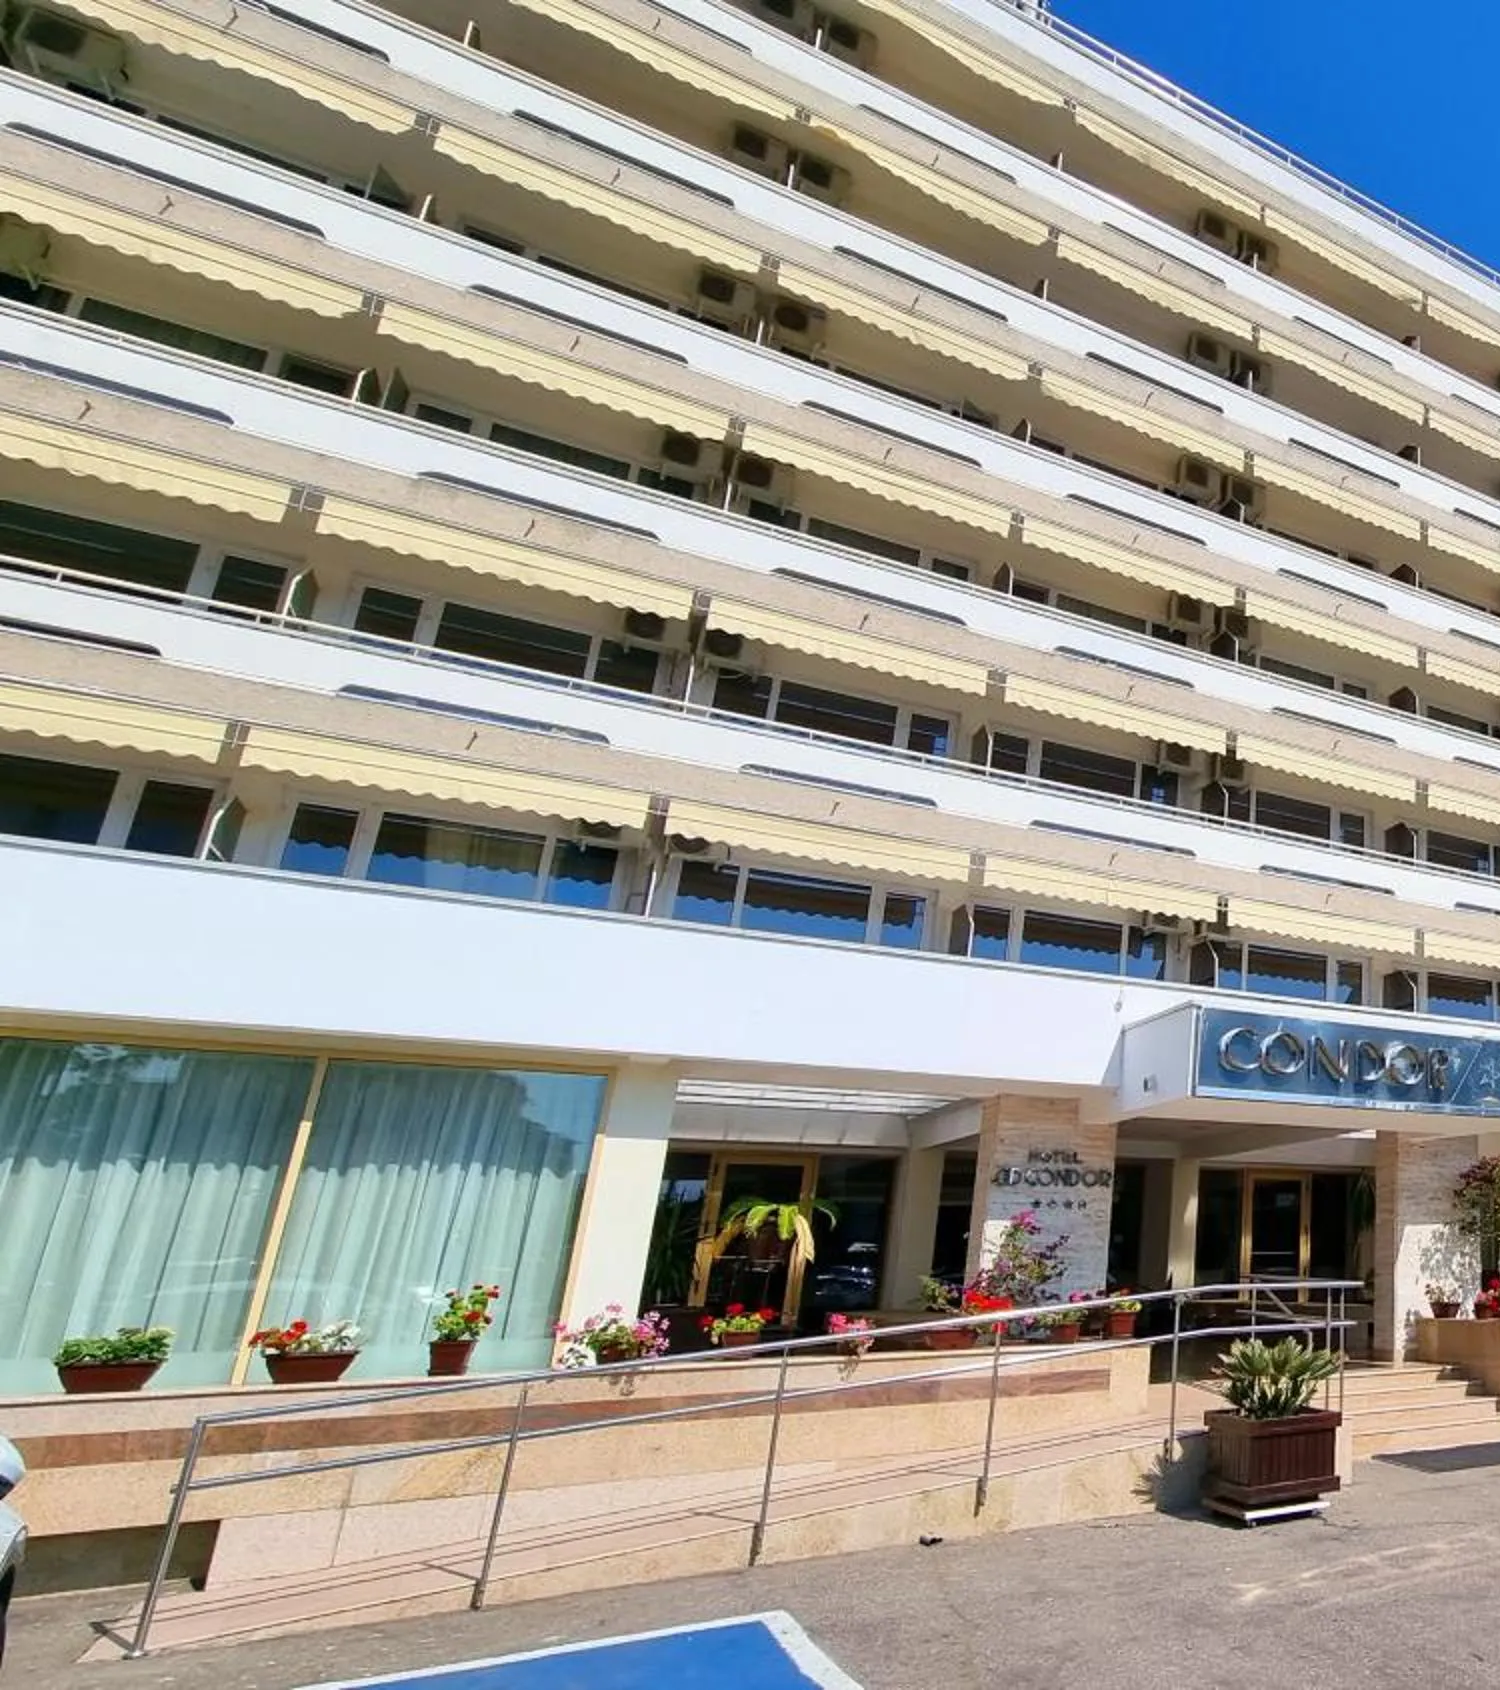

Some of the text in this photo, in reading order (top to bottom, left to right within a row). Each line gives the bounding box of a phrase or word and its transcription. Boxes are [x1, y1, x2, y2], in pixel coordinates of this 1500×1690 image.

[1219, 1026, 1451, 1091] CONDOR
[1028, 1149, 1084, 1165] HOTEL
[1023, 1167, 1113, 1188] CONDOR
